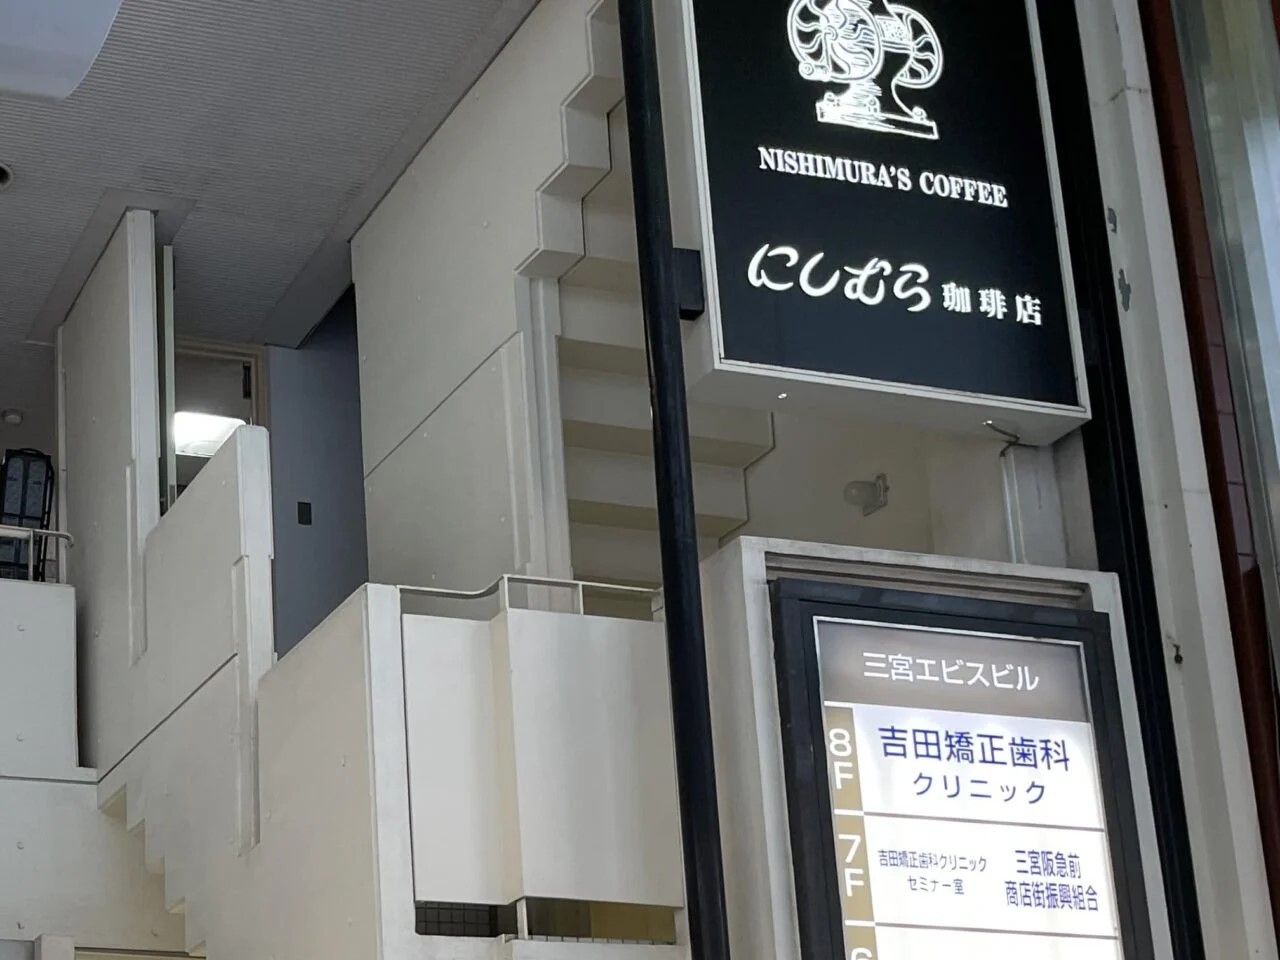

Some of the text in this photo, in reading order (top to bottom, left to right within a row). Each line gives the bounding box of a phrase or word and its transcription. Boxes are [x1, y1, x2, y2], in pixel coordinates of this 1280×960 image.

[758, 147, 1008, 207] NISHIMURA'S COFFEE
[863, 651, 1039, 691] 三宮エビスビル
[878, 725, 1069, 771] 吉田矯正歯科
[913, 773, 1046, 804] クリニック
[878, 849, 987, 872] 吉田矯正歯科クリニック
[1015, 849, 1082, 879] 三宮阪急前
[907, 875, 1099, 912] セミナー室 商店街振興組合
